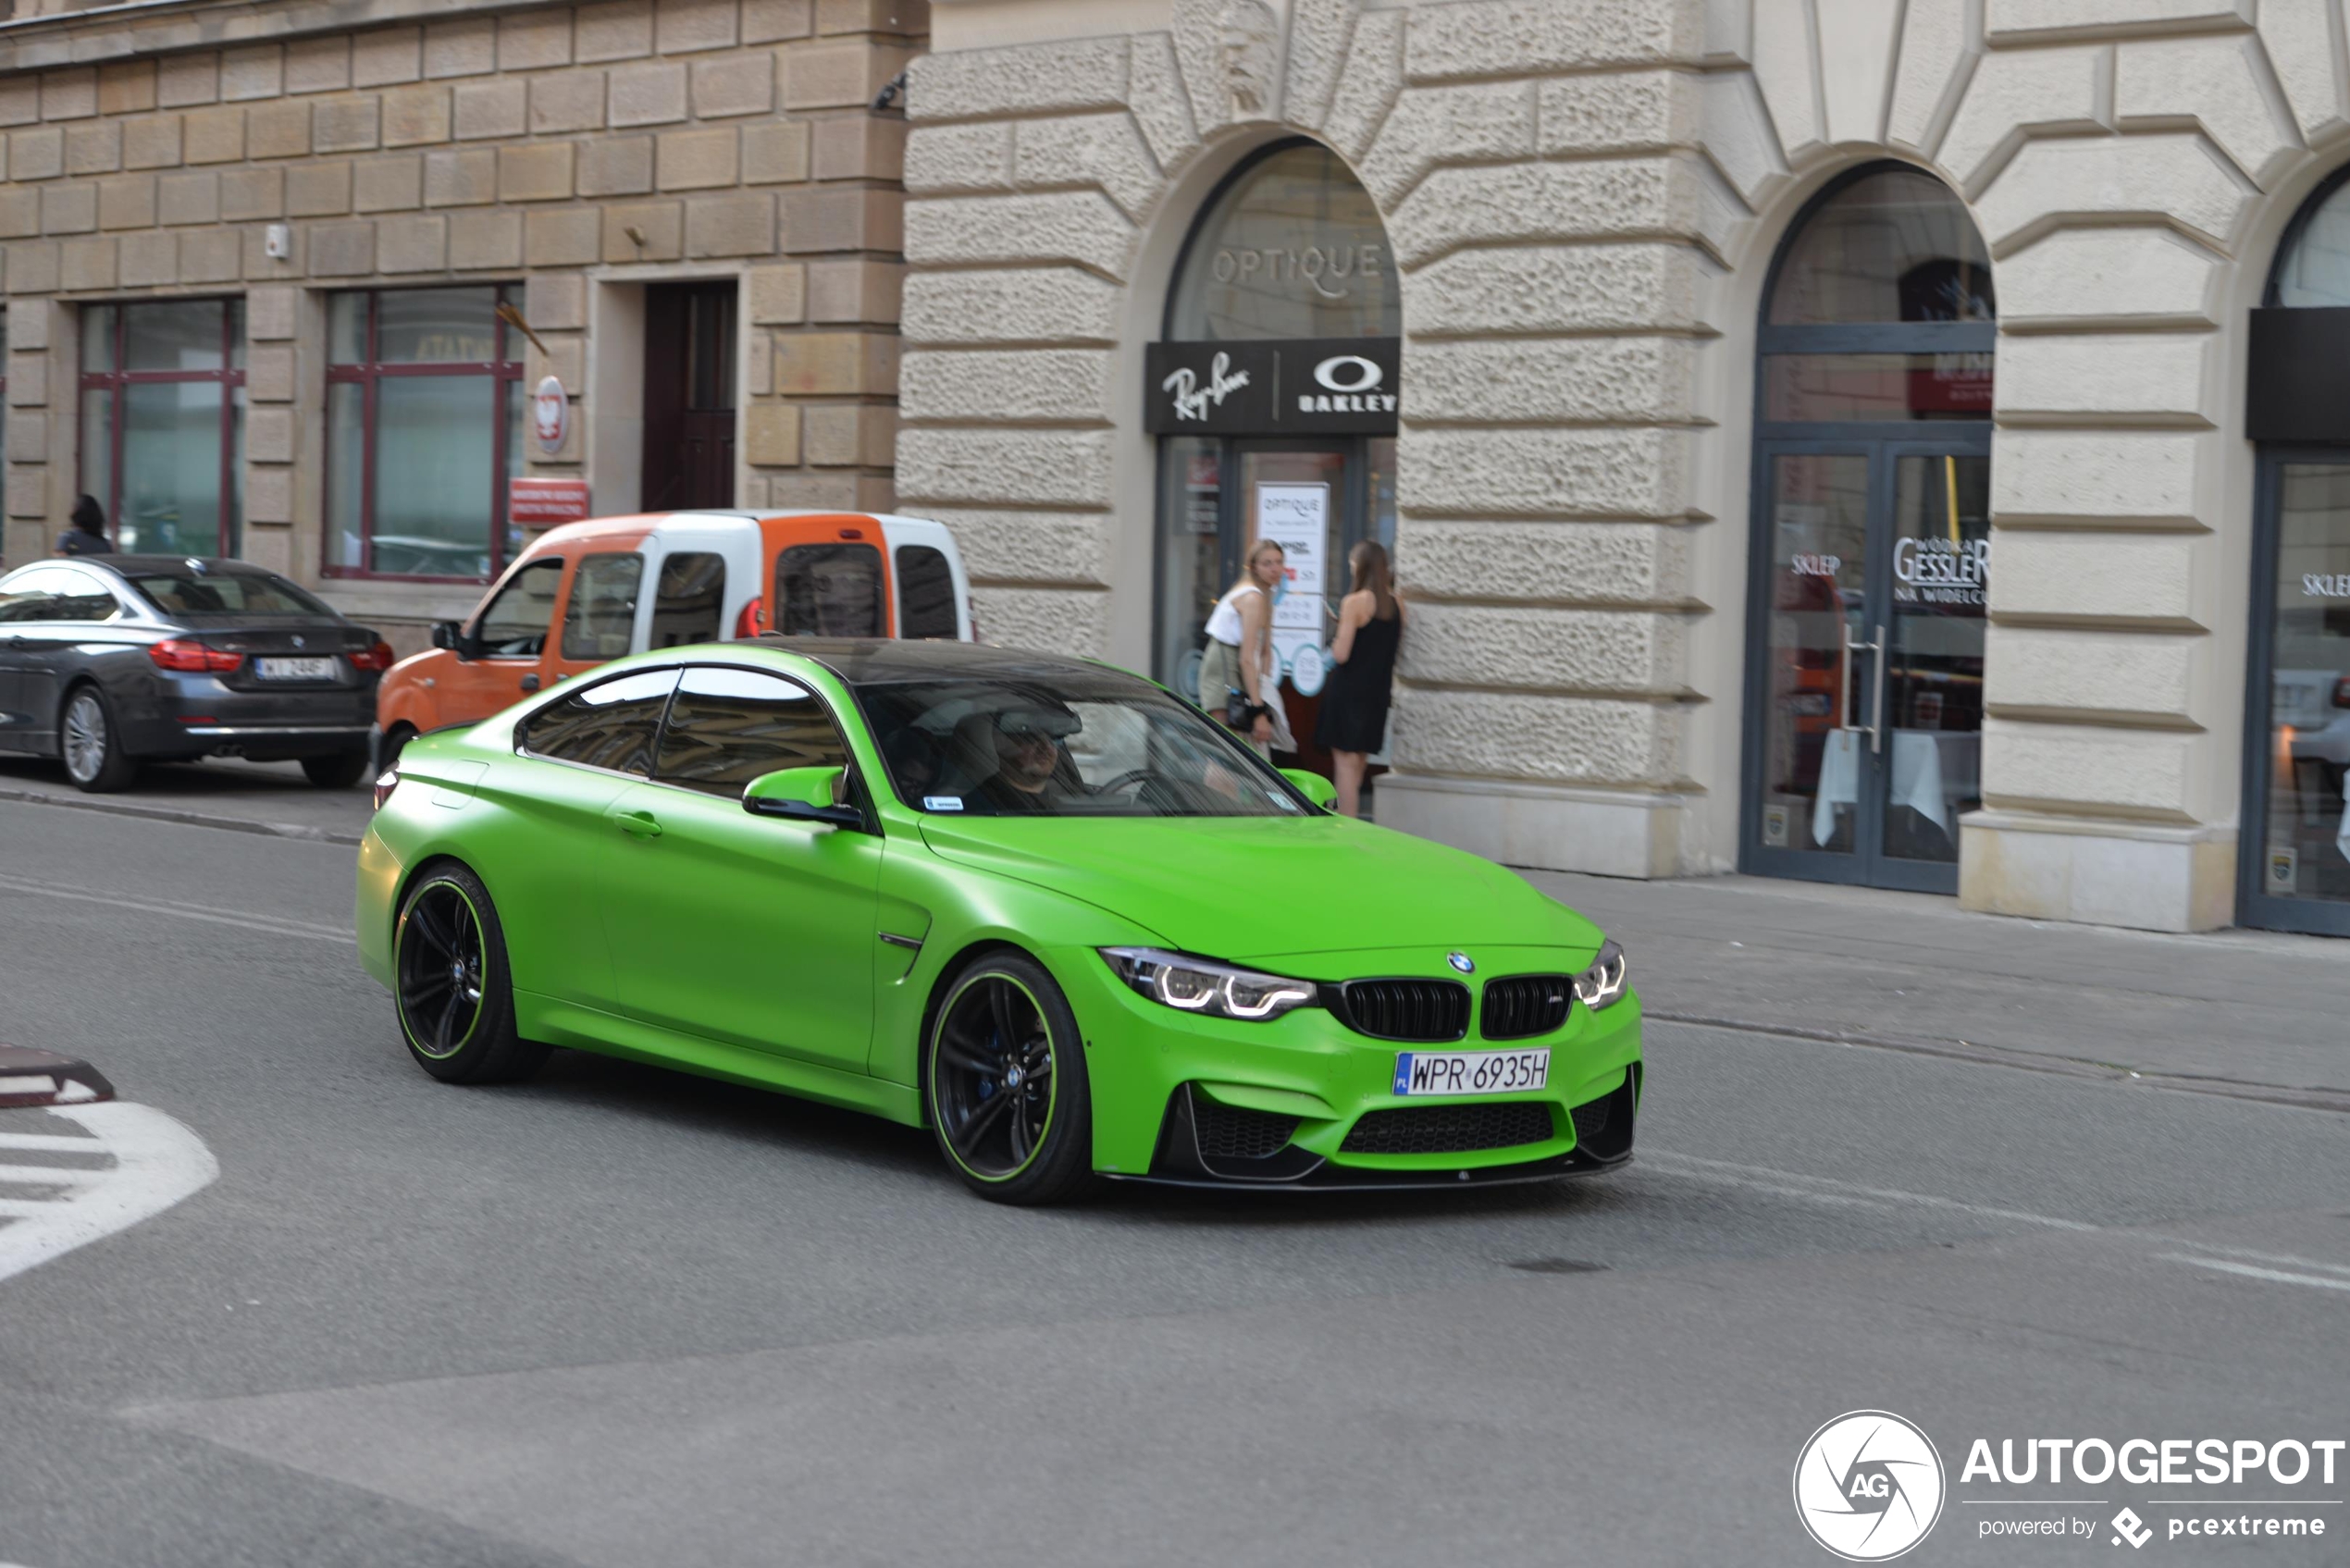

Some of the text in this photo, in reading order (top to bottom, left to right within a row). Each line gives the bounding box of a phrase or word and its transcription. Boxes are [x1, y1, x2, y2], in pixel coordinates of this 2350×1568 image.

[1212, 244, 1382, 299] OPTIQUE
[1298, 394, 1398, 413] OAKLEY
[1791, 554, 1841, 575] SKLEP
[1893, 537, 1992, 584] GESSLER
[1894, 587, 1919, 602] NA
[1413, 1053, 1549, 1091] WPR 6935H
[1396, 1078, 1407, 1089] PL
